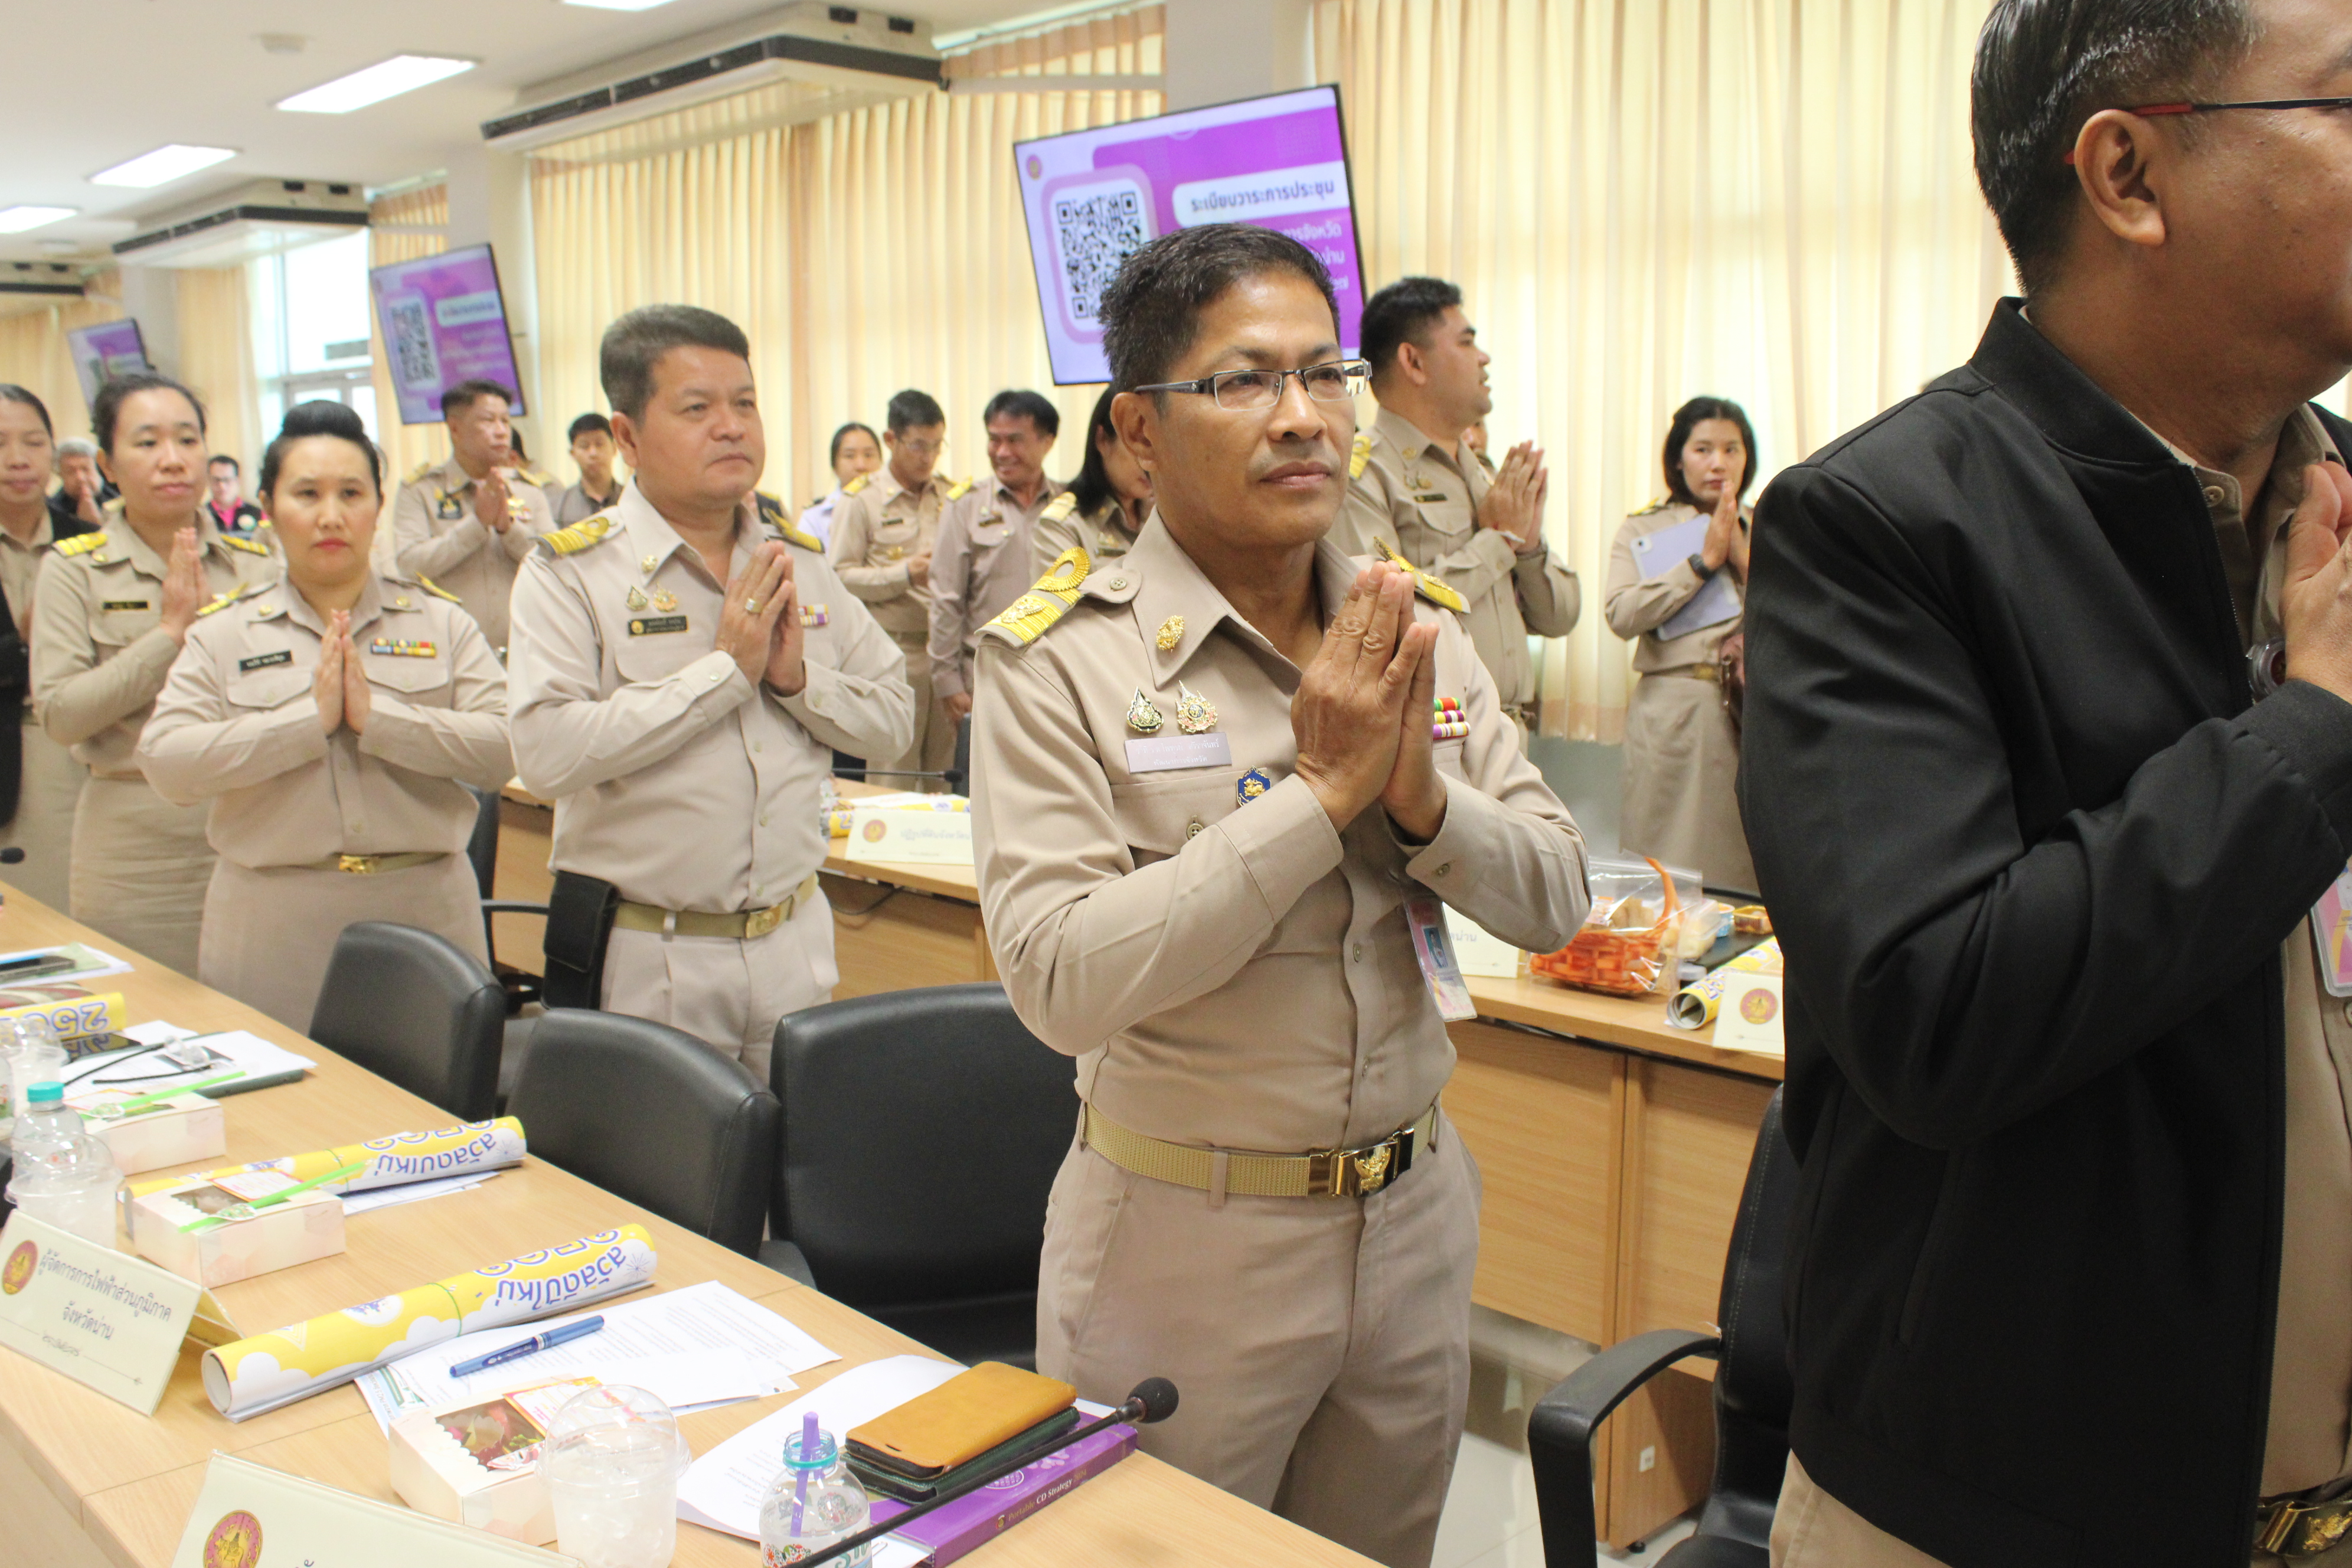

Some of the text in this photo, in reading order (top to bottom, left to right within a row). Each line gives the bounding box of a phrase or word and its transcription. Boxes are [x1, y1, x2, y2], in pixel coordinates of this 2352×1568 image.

[1190, 179, 1335, 213] ระเบียบวาระการประชุม
[38, 1247, 172, 1322] ผู้จัดการการไฟฟ้าส่วนภูมิภาค
[494, 1245, 627, 1311] สวัสดีปีใหม่
[62, 1300, 115, 1341] จังหวัดน่าน
[1035, 1492, 1047, 1504] CD
[1047, 1478, 1073, 1499] Strategy
